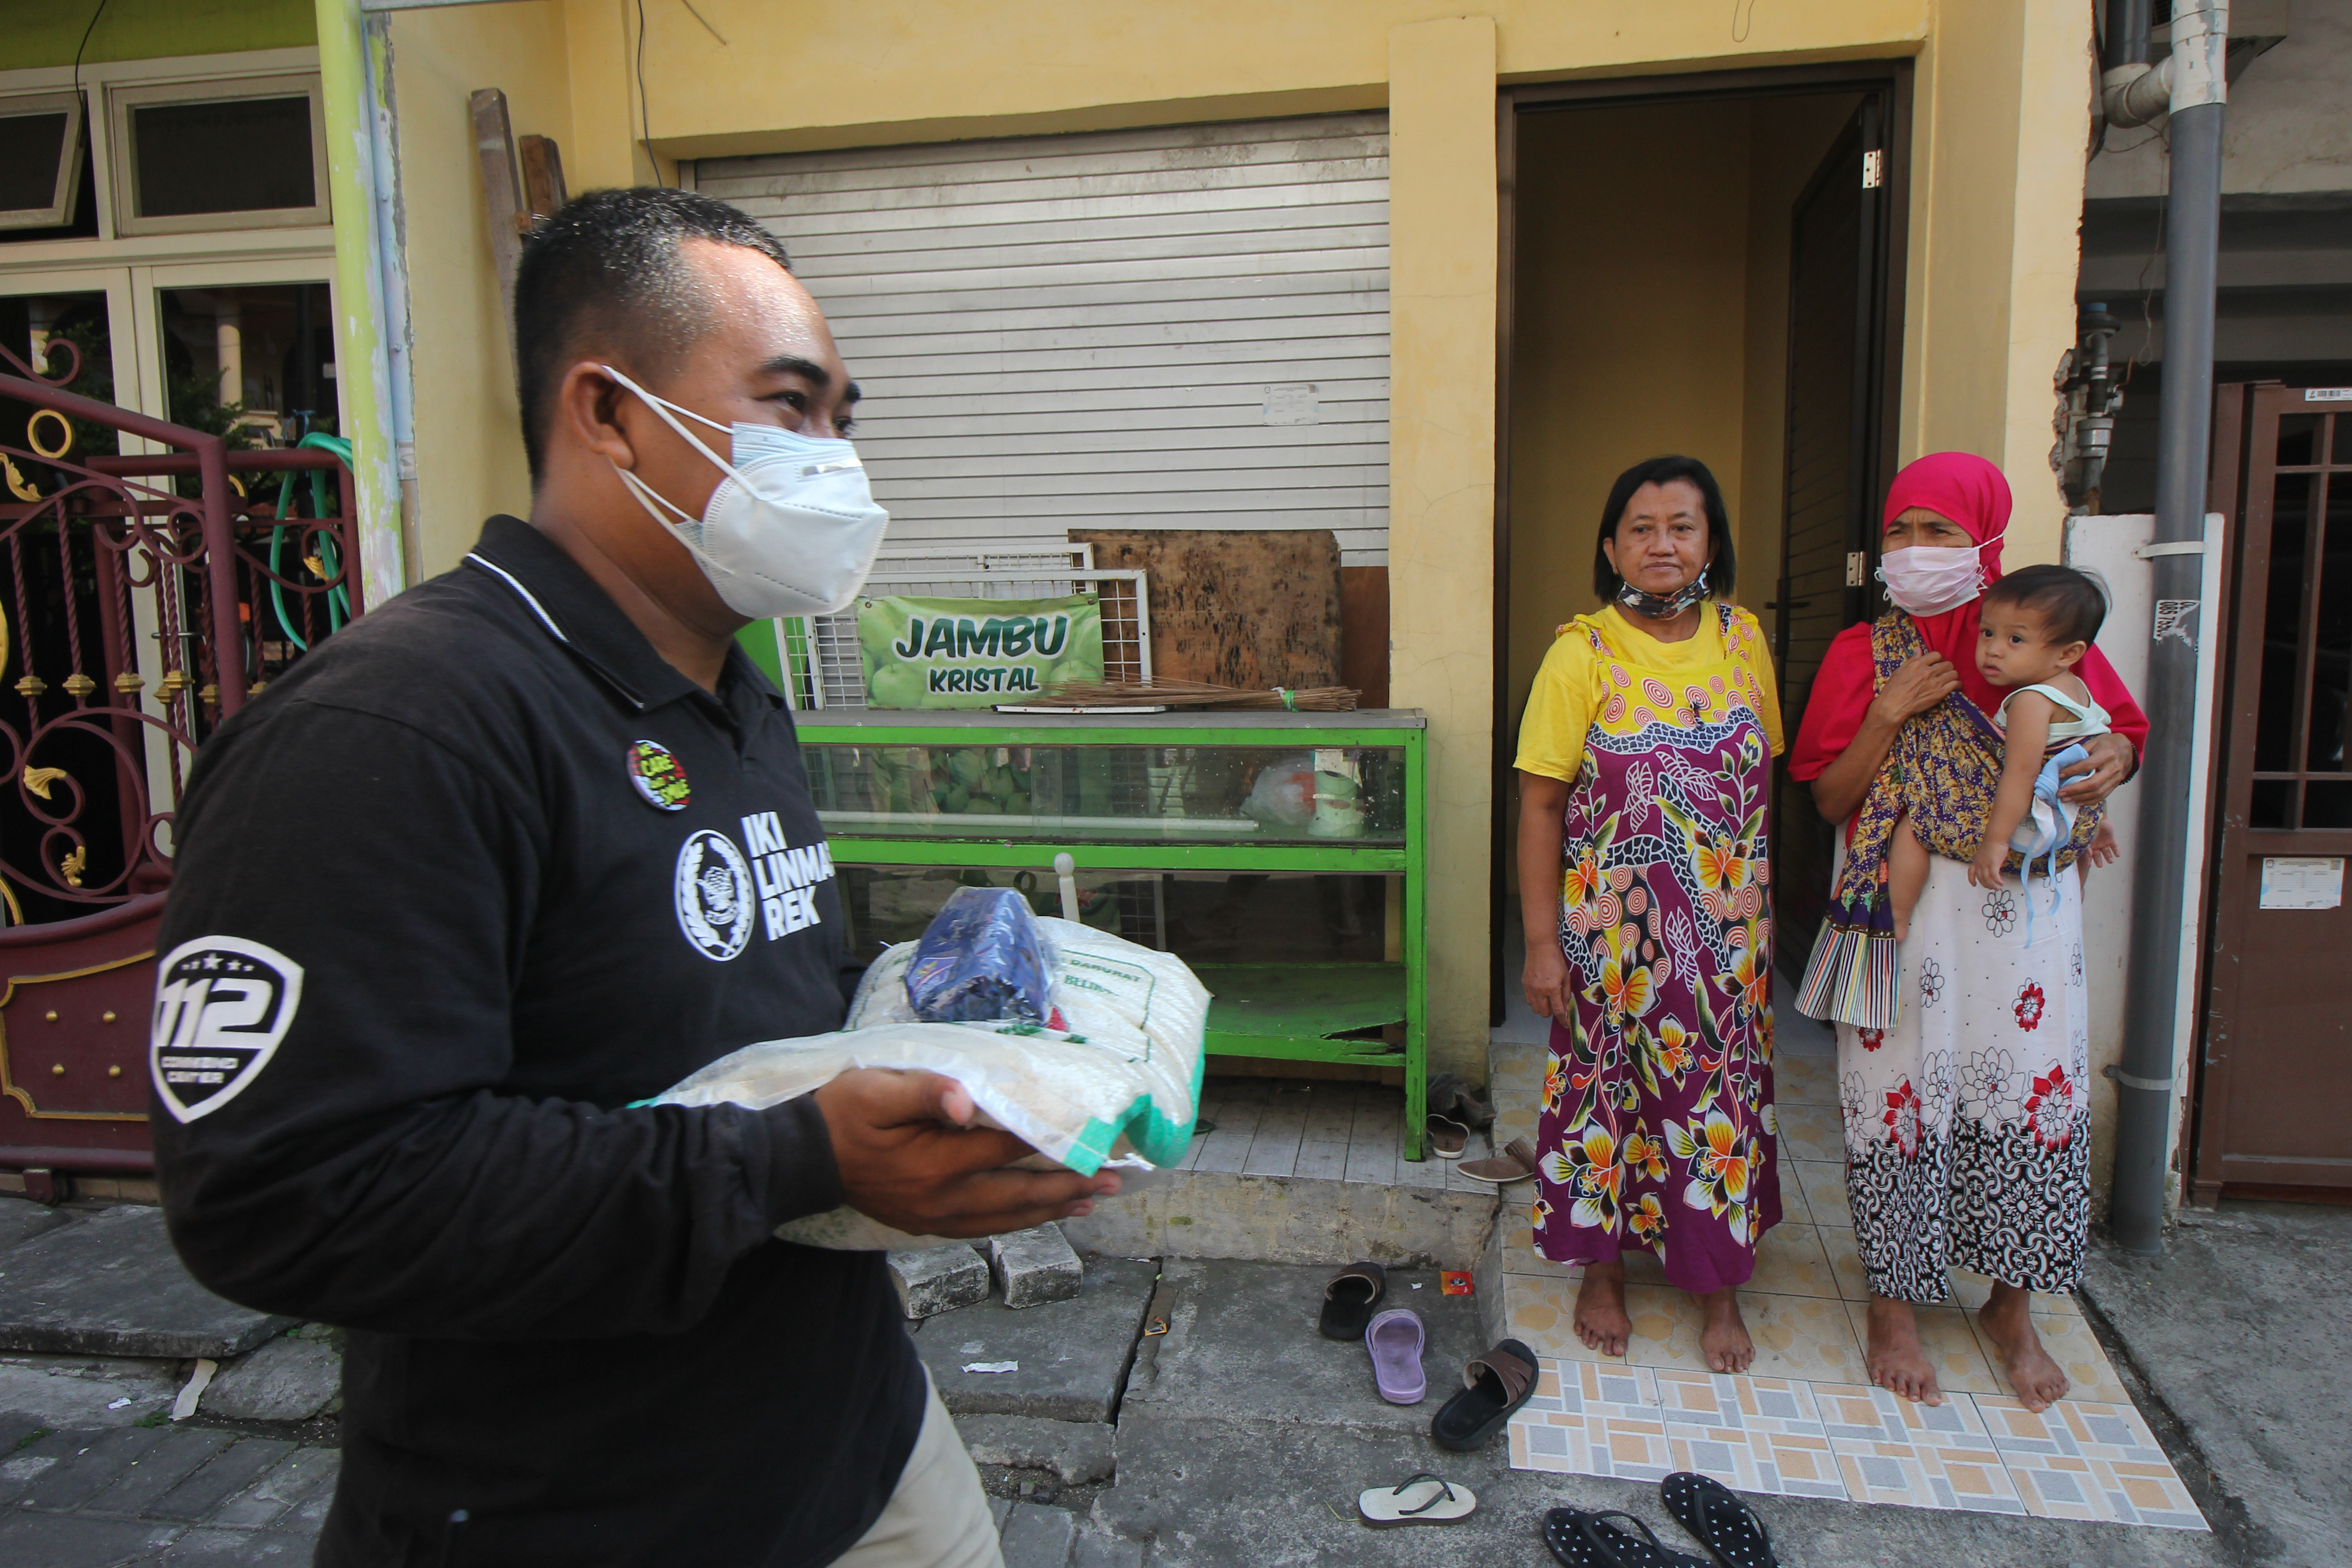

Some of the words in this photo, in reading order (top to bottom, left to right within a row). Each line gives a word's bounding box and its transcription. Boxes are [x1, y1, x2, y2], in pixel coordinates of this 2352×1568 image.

[2158, 601, 2179, 614] 085
[896, 615, 1067, 658] JAMBU
[930, 667, 1040, 692] KRISTAL
[740, 811, 788, 858] IKI
[762, 885, 821, 941] REK
[1070, 959, 1142, 982] DARURAT
[157, 977, 273, 1048] 112
